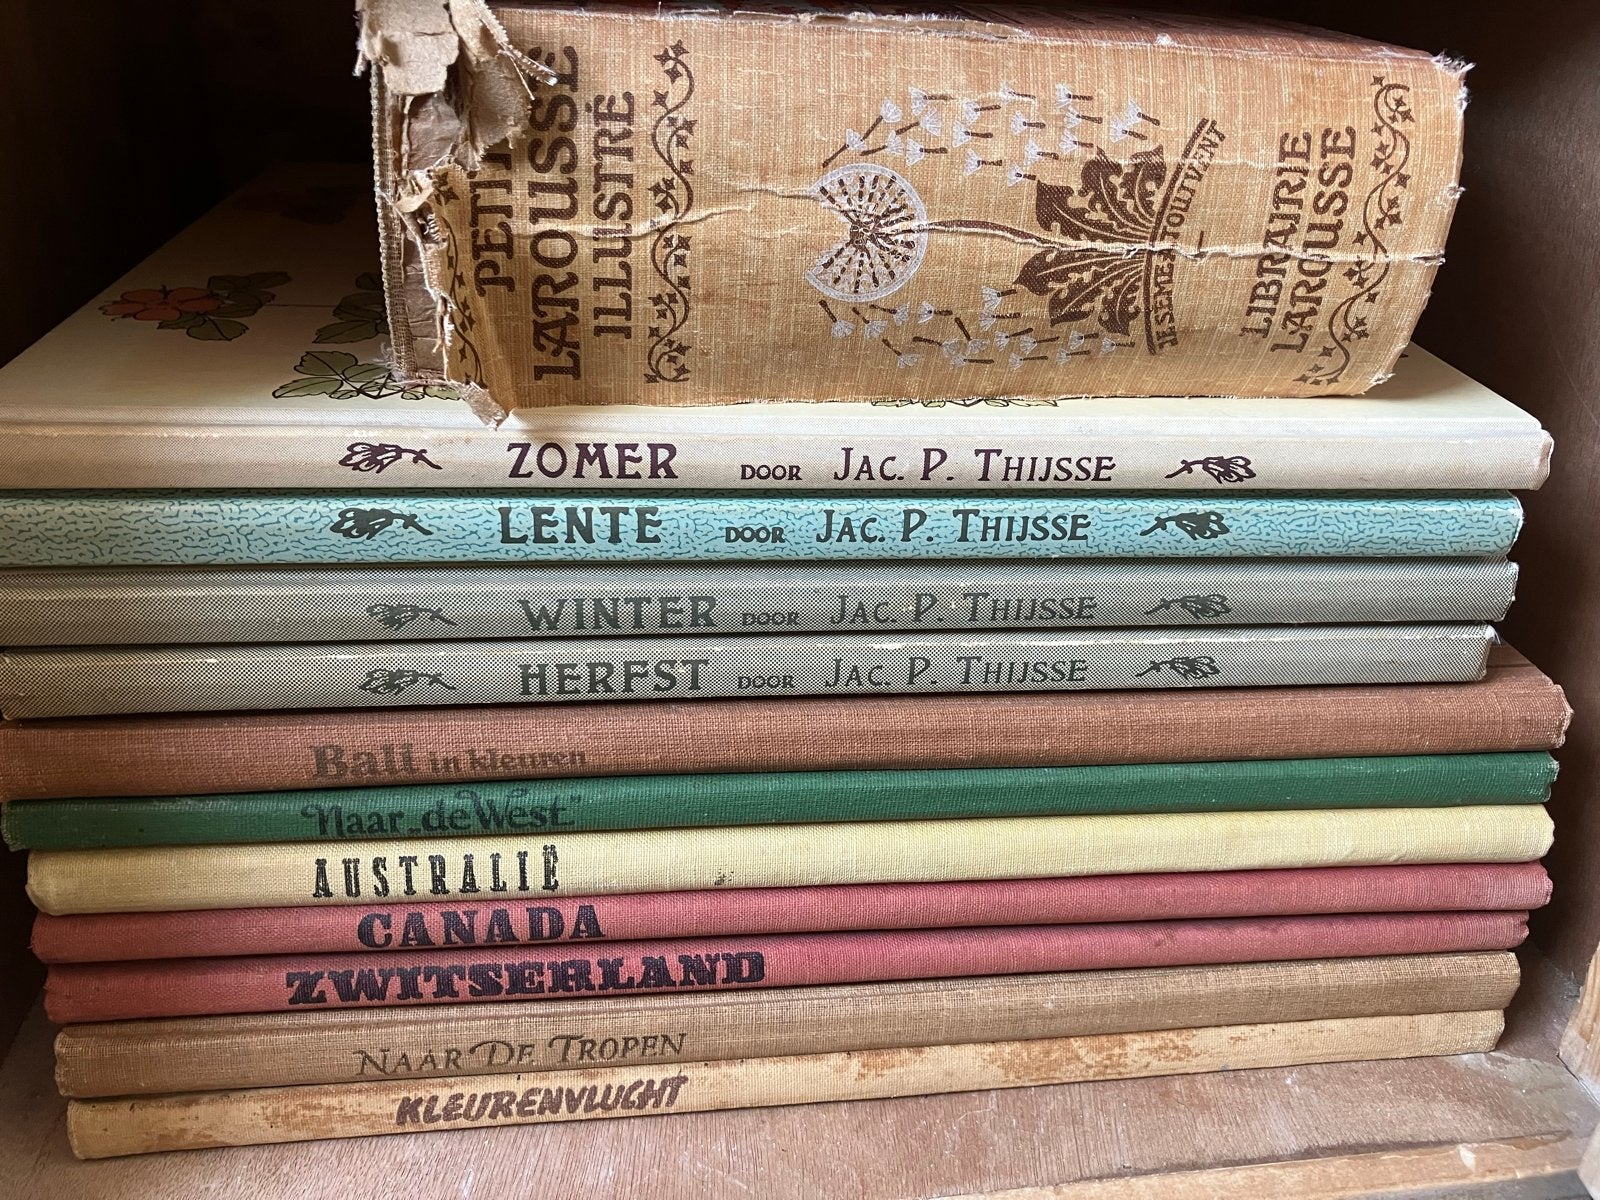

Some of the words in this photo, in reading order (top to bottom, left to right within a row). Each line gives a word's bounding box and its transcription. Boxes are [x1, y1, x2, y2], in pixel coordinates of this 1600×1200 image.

[1184, 120, 1226, 182] VENT
[528, 45, 582, 381] LAROUSSE
[585, 91, 635, 339] ILLUSTRÉ
[1160, 181, 1195, 242] TOUT
[1240, 132, 1312, 338] LIBRAIRIE
[1271, 126, 1356, 354] LAROUSSE
[1156, 326, 1178, 349] JE
[506, 442, 678, 480] ZOMER
[740, 464, 802, 481] DOOR
[920, 447, 954, 482] P.
[974, 448, 1116, 482] THIJSSE
[498, 506, 662, 544] LENTE
[725, 527, 786, 543] DOOR
[901, 509, 932, 542] P.
[953, 509, 1091, 542] THIJSSE
[517, 596, 717, 631] WINTER
[741, 611, 800, 627] DOOR
[913, 593, 944, 624] P.
[963, 592, 1098, 623] THIJSSE
[518, 659, 709, 696] HERFST
[737, 675, 795, 690] DOOR
[908, 657, 938, 686] P.
[957, 655, 1088, 686] THIJSSE
[311, 742, 416, 778] Bali
[429, 750, 462, 774] in
[468, 747, 589, 773] kleuren
[301, 802, 405, 837] Naar
[312, 845, 560, 898] AUSTRALIË
[357, 905, 605, 949] CANADA
[286, 951, 766, 1005] ZWITSERLAND
[354, 1047, 462, 1077] NAAR
[548, 1032, 688, 1063] TROPEN
[396, 1070, 689, 1127] KLEURENVLUCHT
